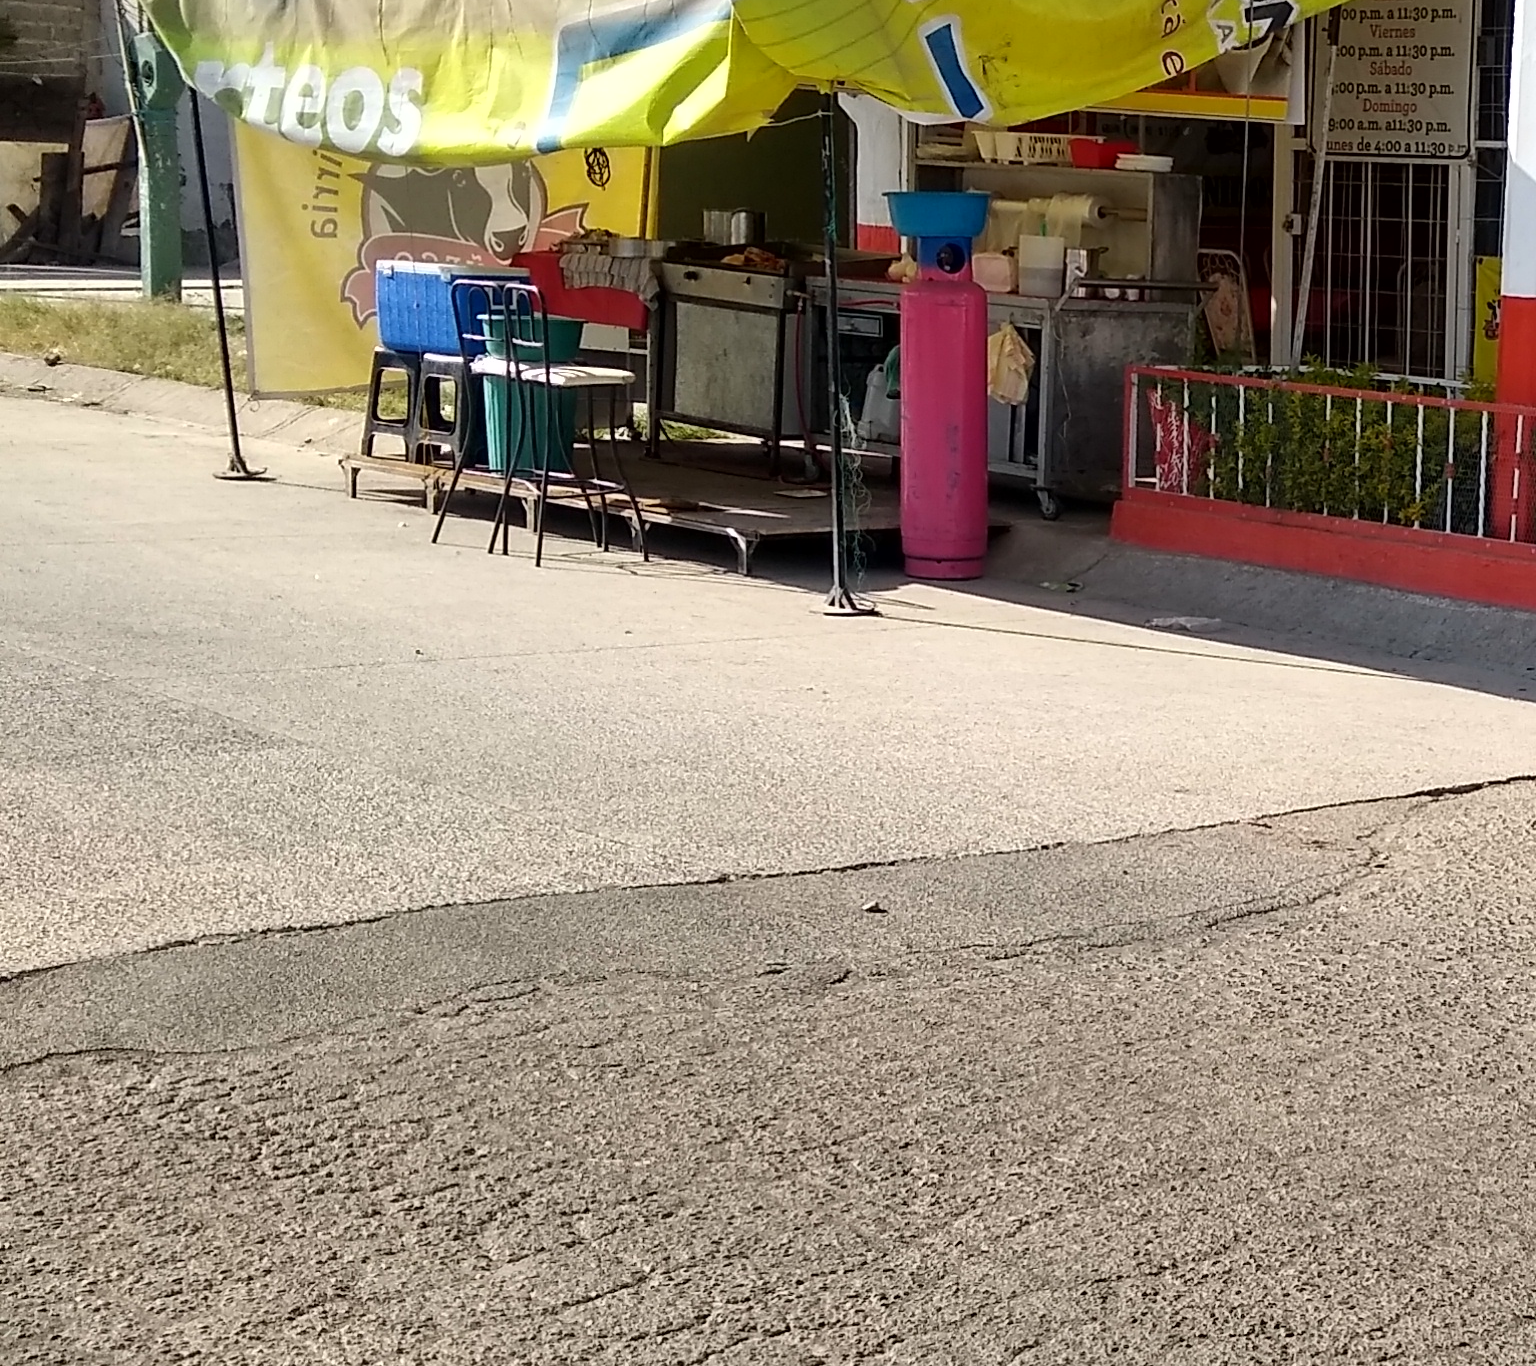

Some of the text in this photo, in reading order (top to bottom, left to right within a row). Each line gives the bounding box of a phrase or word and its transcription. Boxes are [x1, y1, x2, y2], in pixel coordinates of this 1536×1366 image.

[1359, 9, 1384, 23] p.m.
[1397, 7, 1428, 22] 11:30
[1430, 8, 1456, 23] p.m.
[1370, 24, 1416, 39] Viernes
[1336, 45, 1356, 57] :00
[1358, 46, 1383, 60] p.m.
[1396, 45, 1427, 59] 11:30
[1429, 46, 1455, 61] p.m.
[1369, 61, 1413, 76] Sábado
[1331, 82, 1354, 95] :00
[1356, 83, 1382, 99] p.m.
[1394, 82, 1426, 96] 11:30
[1428, 83, 1454, 98] p.m.
[1363, 98, 1417, 116] Domingo
[1328, 117, 1355, 132] 9:00
[1357, 119, 1382, 131] a.m.
[1425, 120, 1451, 135] p.m.
[1326, 141, 1353, 152] unes
[1357, 137, 1371, 152] de
[1375, 140, 1402, 154] 4:00
[1414, 141, 1446, 154] 11:30
